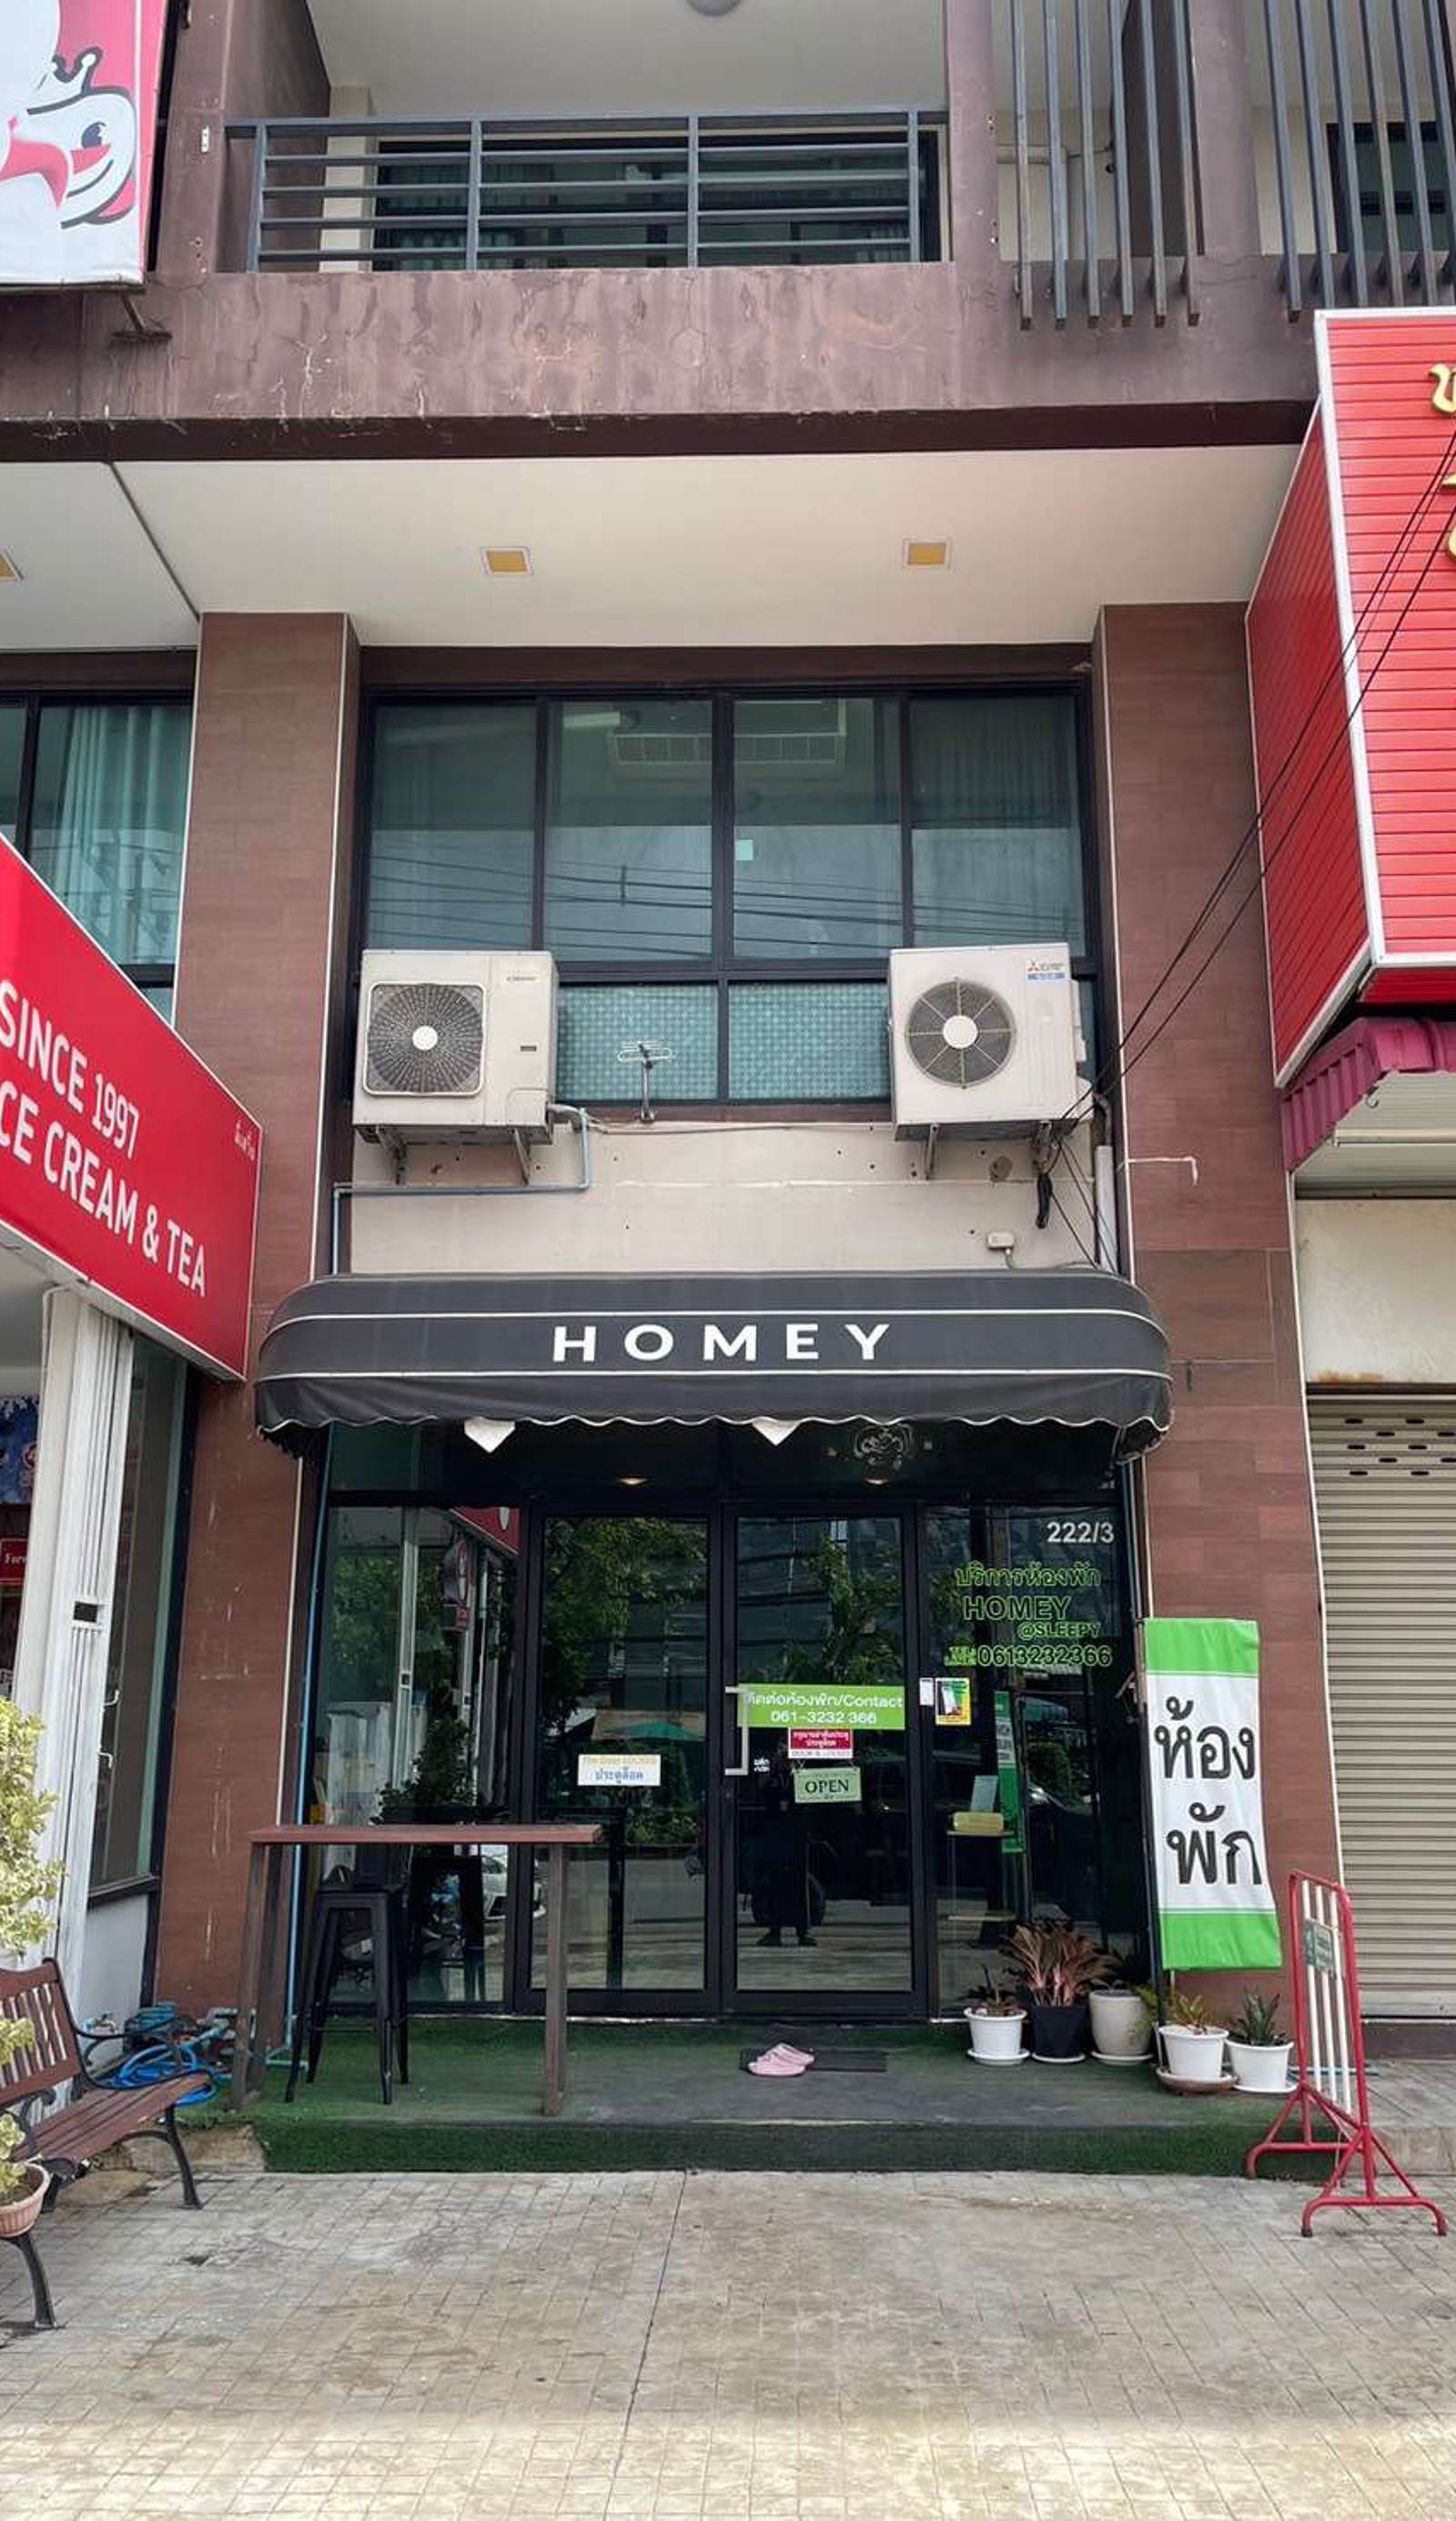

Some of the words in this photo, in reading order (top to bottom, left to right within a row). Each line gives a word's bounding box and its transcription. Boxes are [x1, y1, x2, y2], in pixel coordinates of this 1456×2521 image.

[0, 979, 87, 1115] SINCE
[92, 1072, 139, 1160] 1997
[44, 1120, 138, 1245] CREAM
[142, 1204, 160, 1263] &
[167, 1219, 205, 1298] TEA
[552, 1323, 890, 1363] HOMEY
[1046, 1522, 1115, 1544] 222/3
[963, 1595, 1072, 1621] HOMEY
[1017, 1621, 1101, 1641] @SLEEPY
[977, 1645, 1113, 1666] 0613232366
[1154, 1696, 1256, 1779] ห้อง
[804, 1778, 849, 1794] OPEN
[1166, 1801, 1263, 1885] พัก
